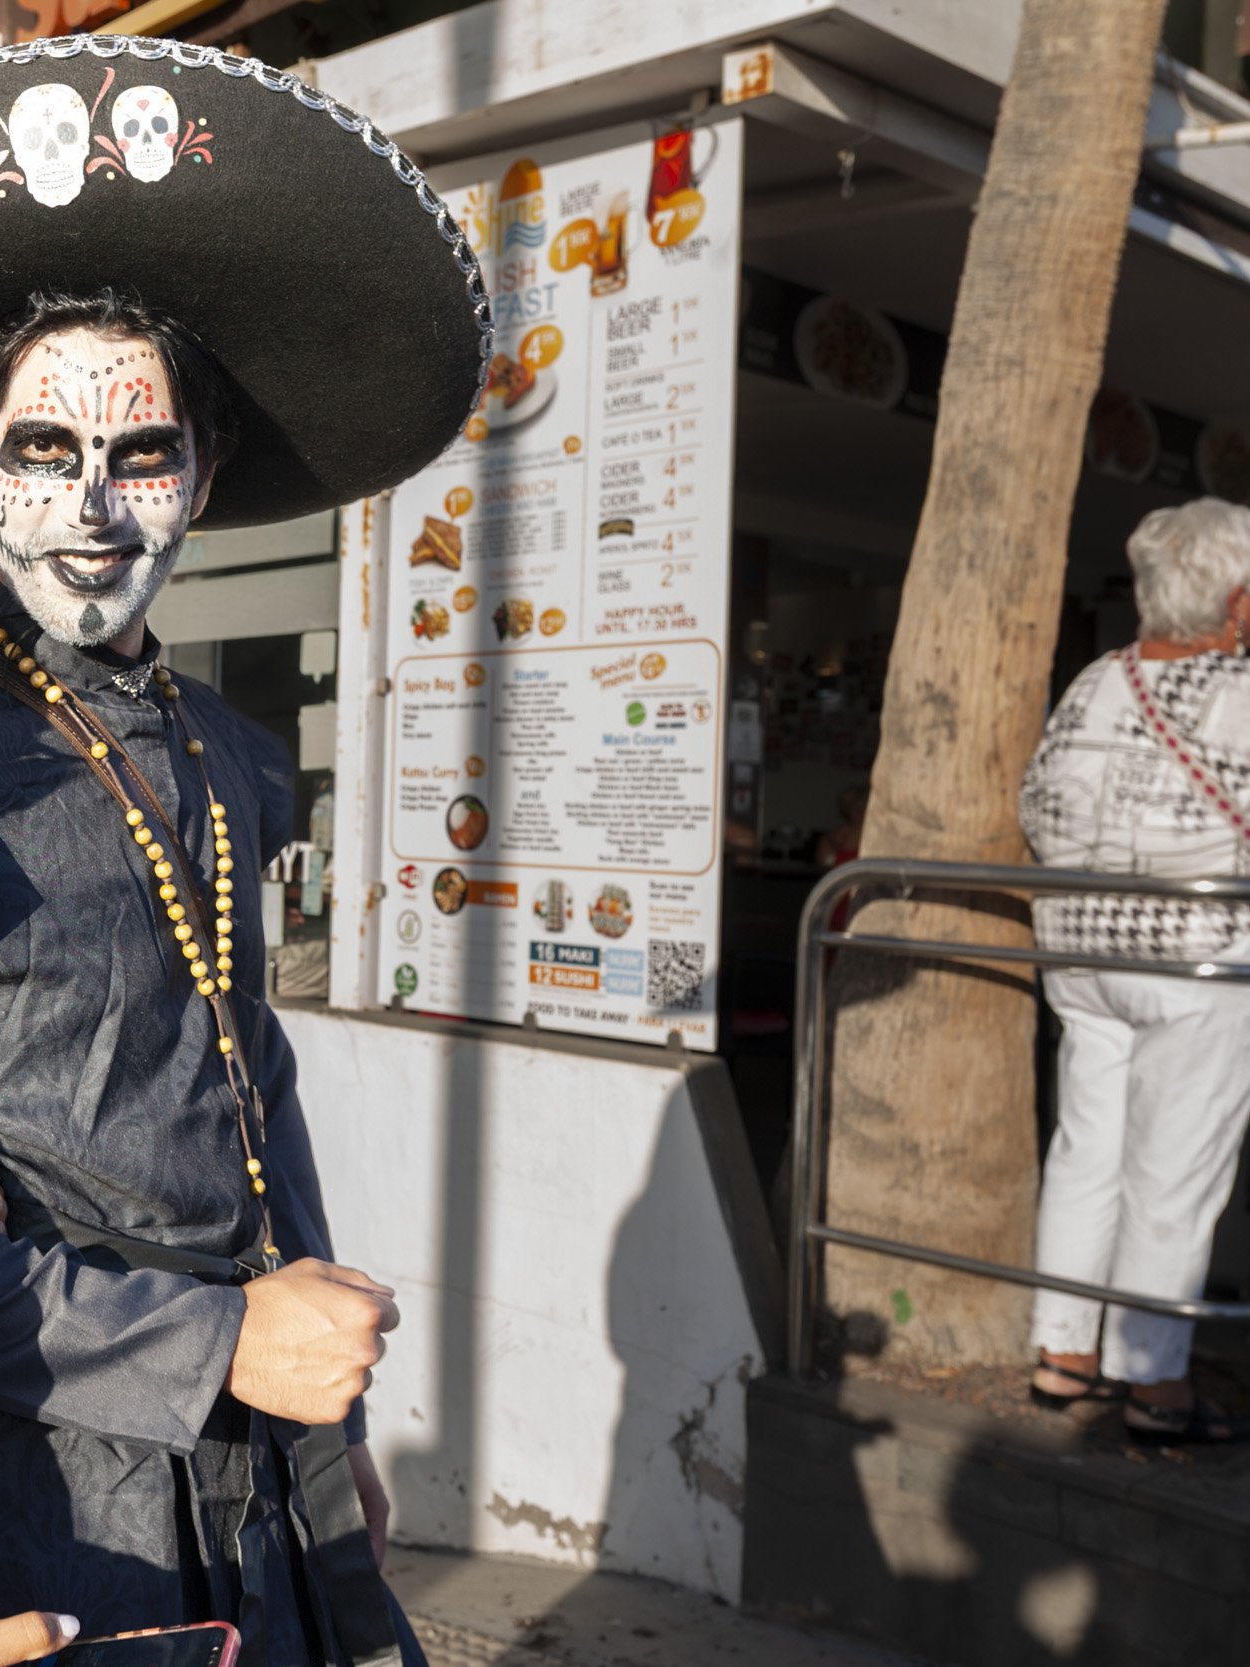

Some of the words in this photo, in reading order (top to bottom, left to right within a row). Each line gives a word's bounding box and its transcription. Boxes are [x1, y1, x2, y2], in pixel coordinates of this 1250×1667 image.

[493, 256, 538, 295] ISH
[493, 281, 559, 322] FAST
[607, 296, 662, 321] LARGE
[606, 314, 651, 341] BEER
[600, 461, 640, 478] CIDER
[599, 491, 639, 508] CIDER
[602, 734, 630, 746] Main
[633, 733, 676, 746] Course
[520, 789, 540, 801] and
[558, 948, 594, 964] MAKI
[554, 970, 594, 988] SUSHI
[557, 1003, 571, 1017] TO
[574, 1006, 597, 1019] TAKE
[601, 1010, 629, 1023] AWAY
